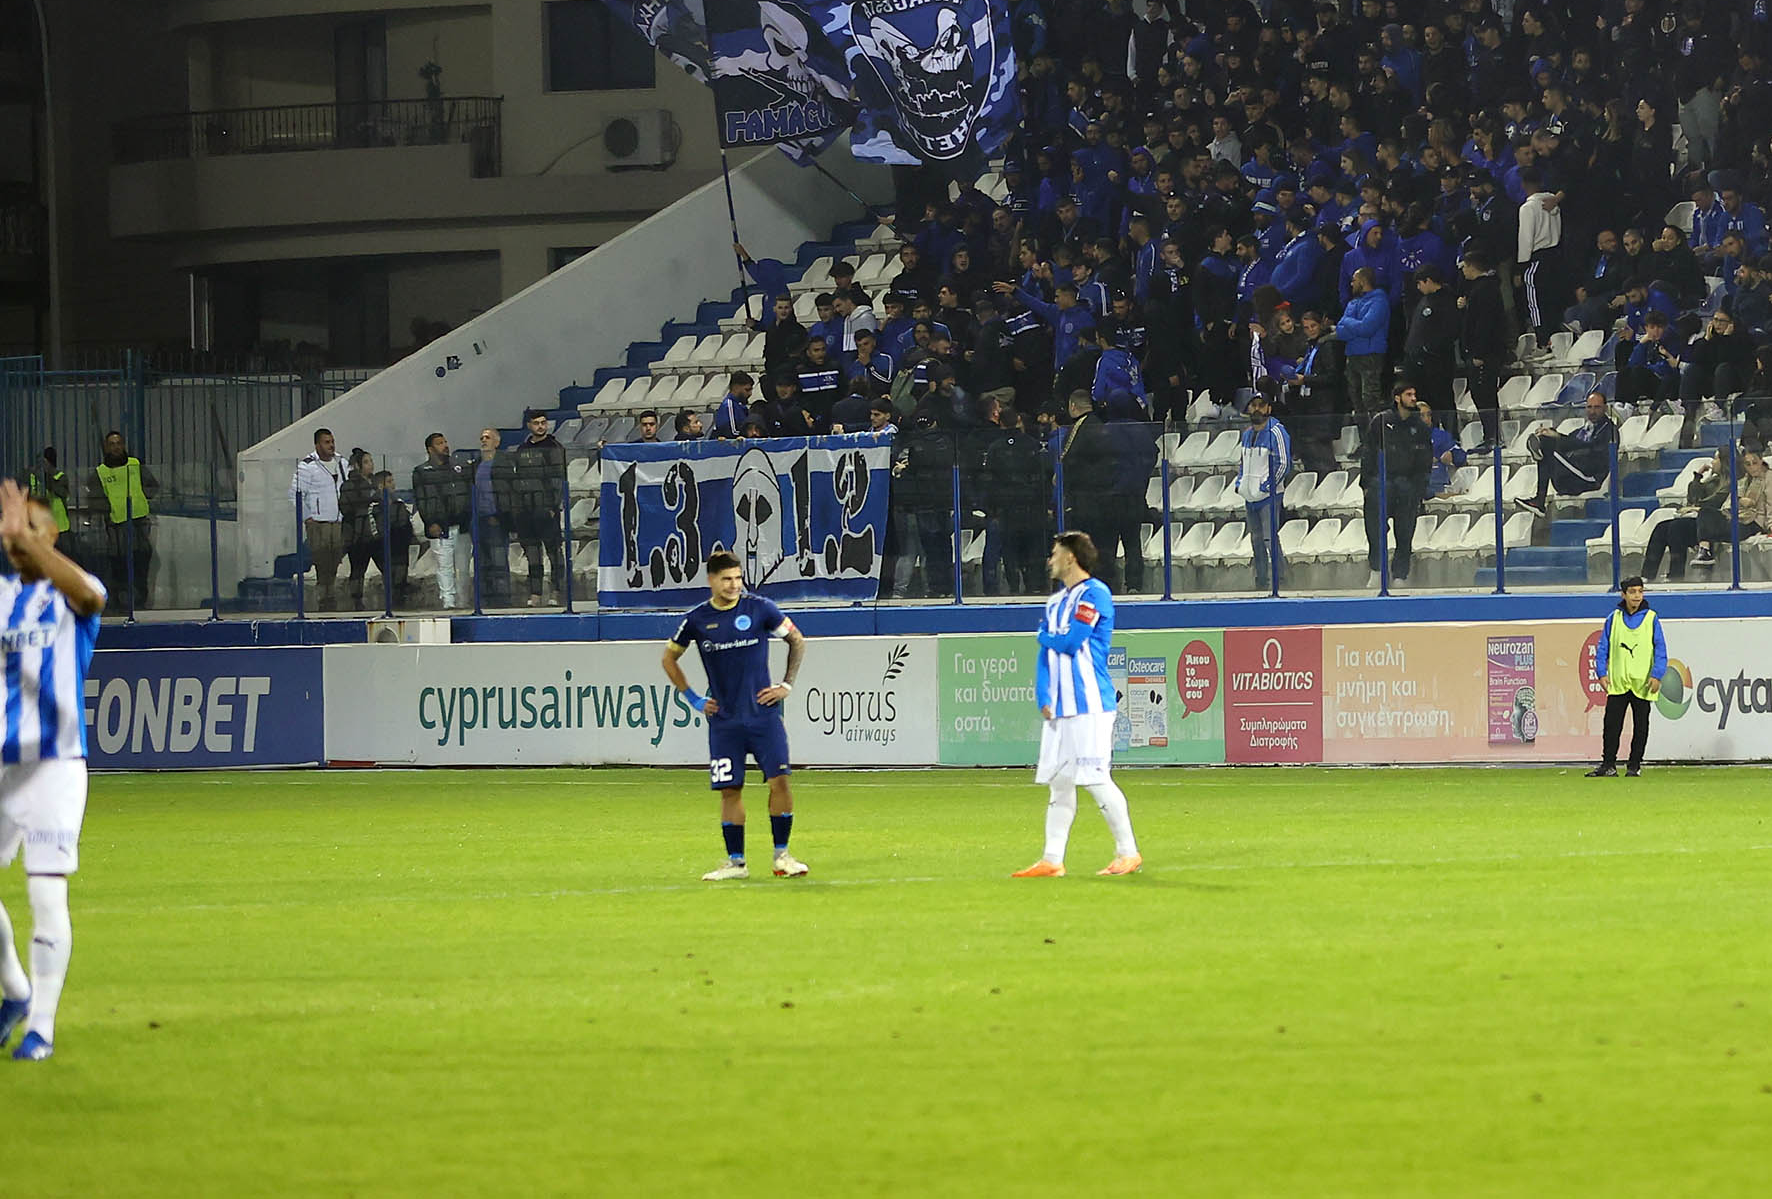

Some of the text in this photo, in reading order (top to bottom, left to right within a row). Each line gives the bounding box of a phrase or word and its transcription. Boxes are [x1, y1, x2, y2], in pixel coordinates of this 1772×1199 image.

[1335, 643, 1406, 672] Για καλή
[1488, 642, 1534, 656] Neurozan
[954, 651, 1018, 678] Για γερά
[1514, 655, 1534, 666] PLUS
[1232, 670, 1314, 692] VITABIOTICS
[1336, 673, 1417, 703] μνήμη και
[954, 685, 977, 703] και
[1240, 717, 1307, 736] Συμπληρώματα
[845, 727, 897, 746] airways
[1249, 733, 1298, 752] Διατροφής
[711, 758, 733, 783] 32
